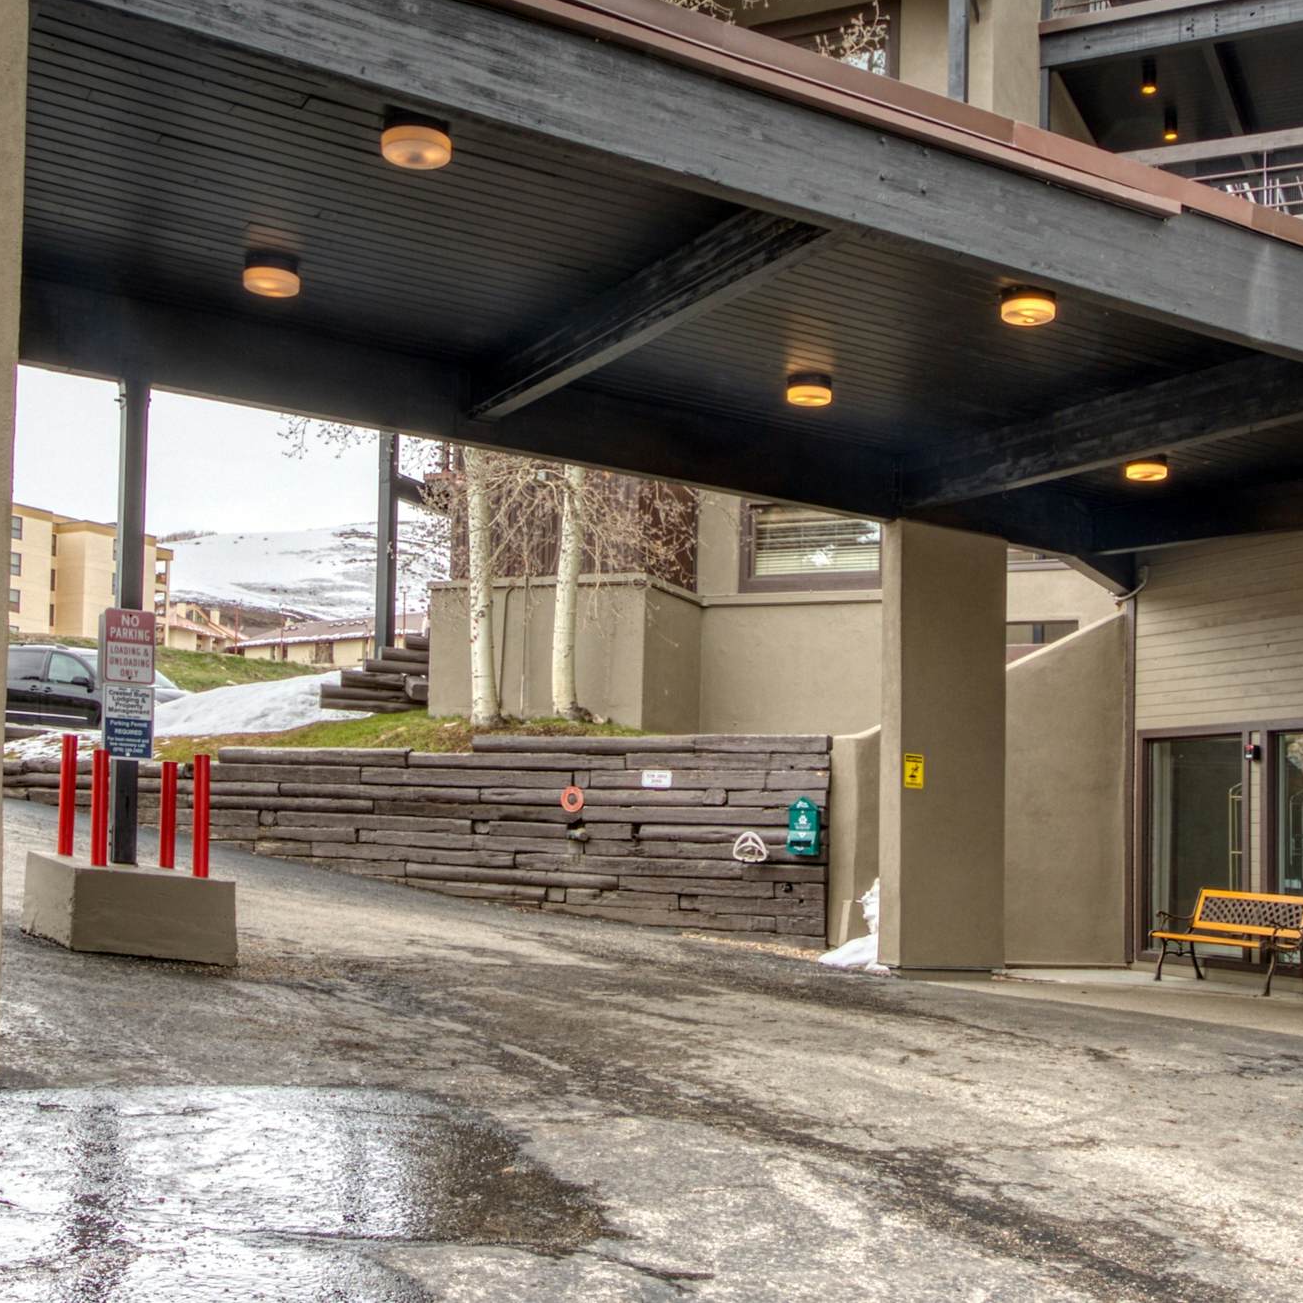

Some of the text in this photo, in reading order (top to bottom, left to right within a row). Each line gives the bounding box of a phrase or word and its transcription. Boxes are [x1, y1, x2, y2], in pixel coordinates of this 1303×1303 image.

[122, 614, 140, 627] NO
[110, 626, 151, 642] PARKING
[110, 645, 141, 656] LOADING
[109, 657, 151, 668] UNLOADING
[120, 668, 139, 677] ONLY
